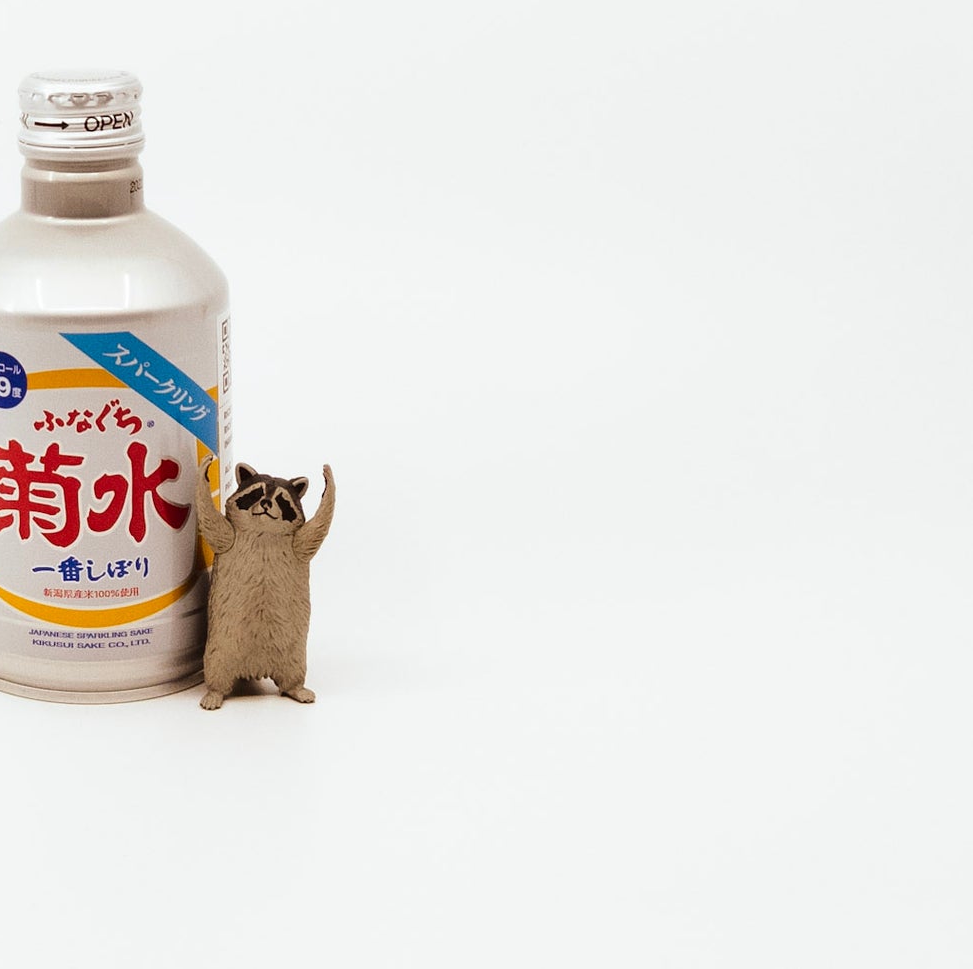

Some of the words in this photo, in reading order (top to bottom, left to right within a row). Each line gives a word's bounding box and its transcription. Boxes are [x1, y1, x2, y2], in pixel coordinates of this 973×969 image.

[84, 111, 134, 132] OPEN
[102, 343, 211, 422] スパークリング
[33, 399, 143, 435] ふなぐち
[31, 556, 149, 582] 一番しぼり
[28, 629, 74, 639] JAPANESE
[76, 631, 128, 640] SPARKLING
[130, 627, 154, 637] SAKE
[32, 638, 74, 649] KIKUSUI
